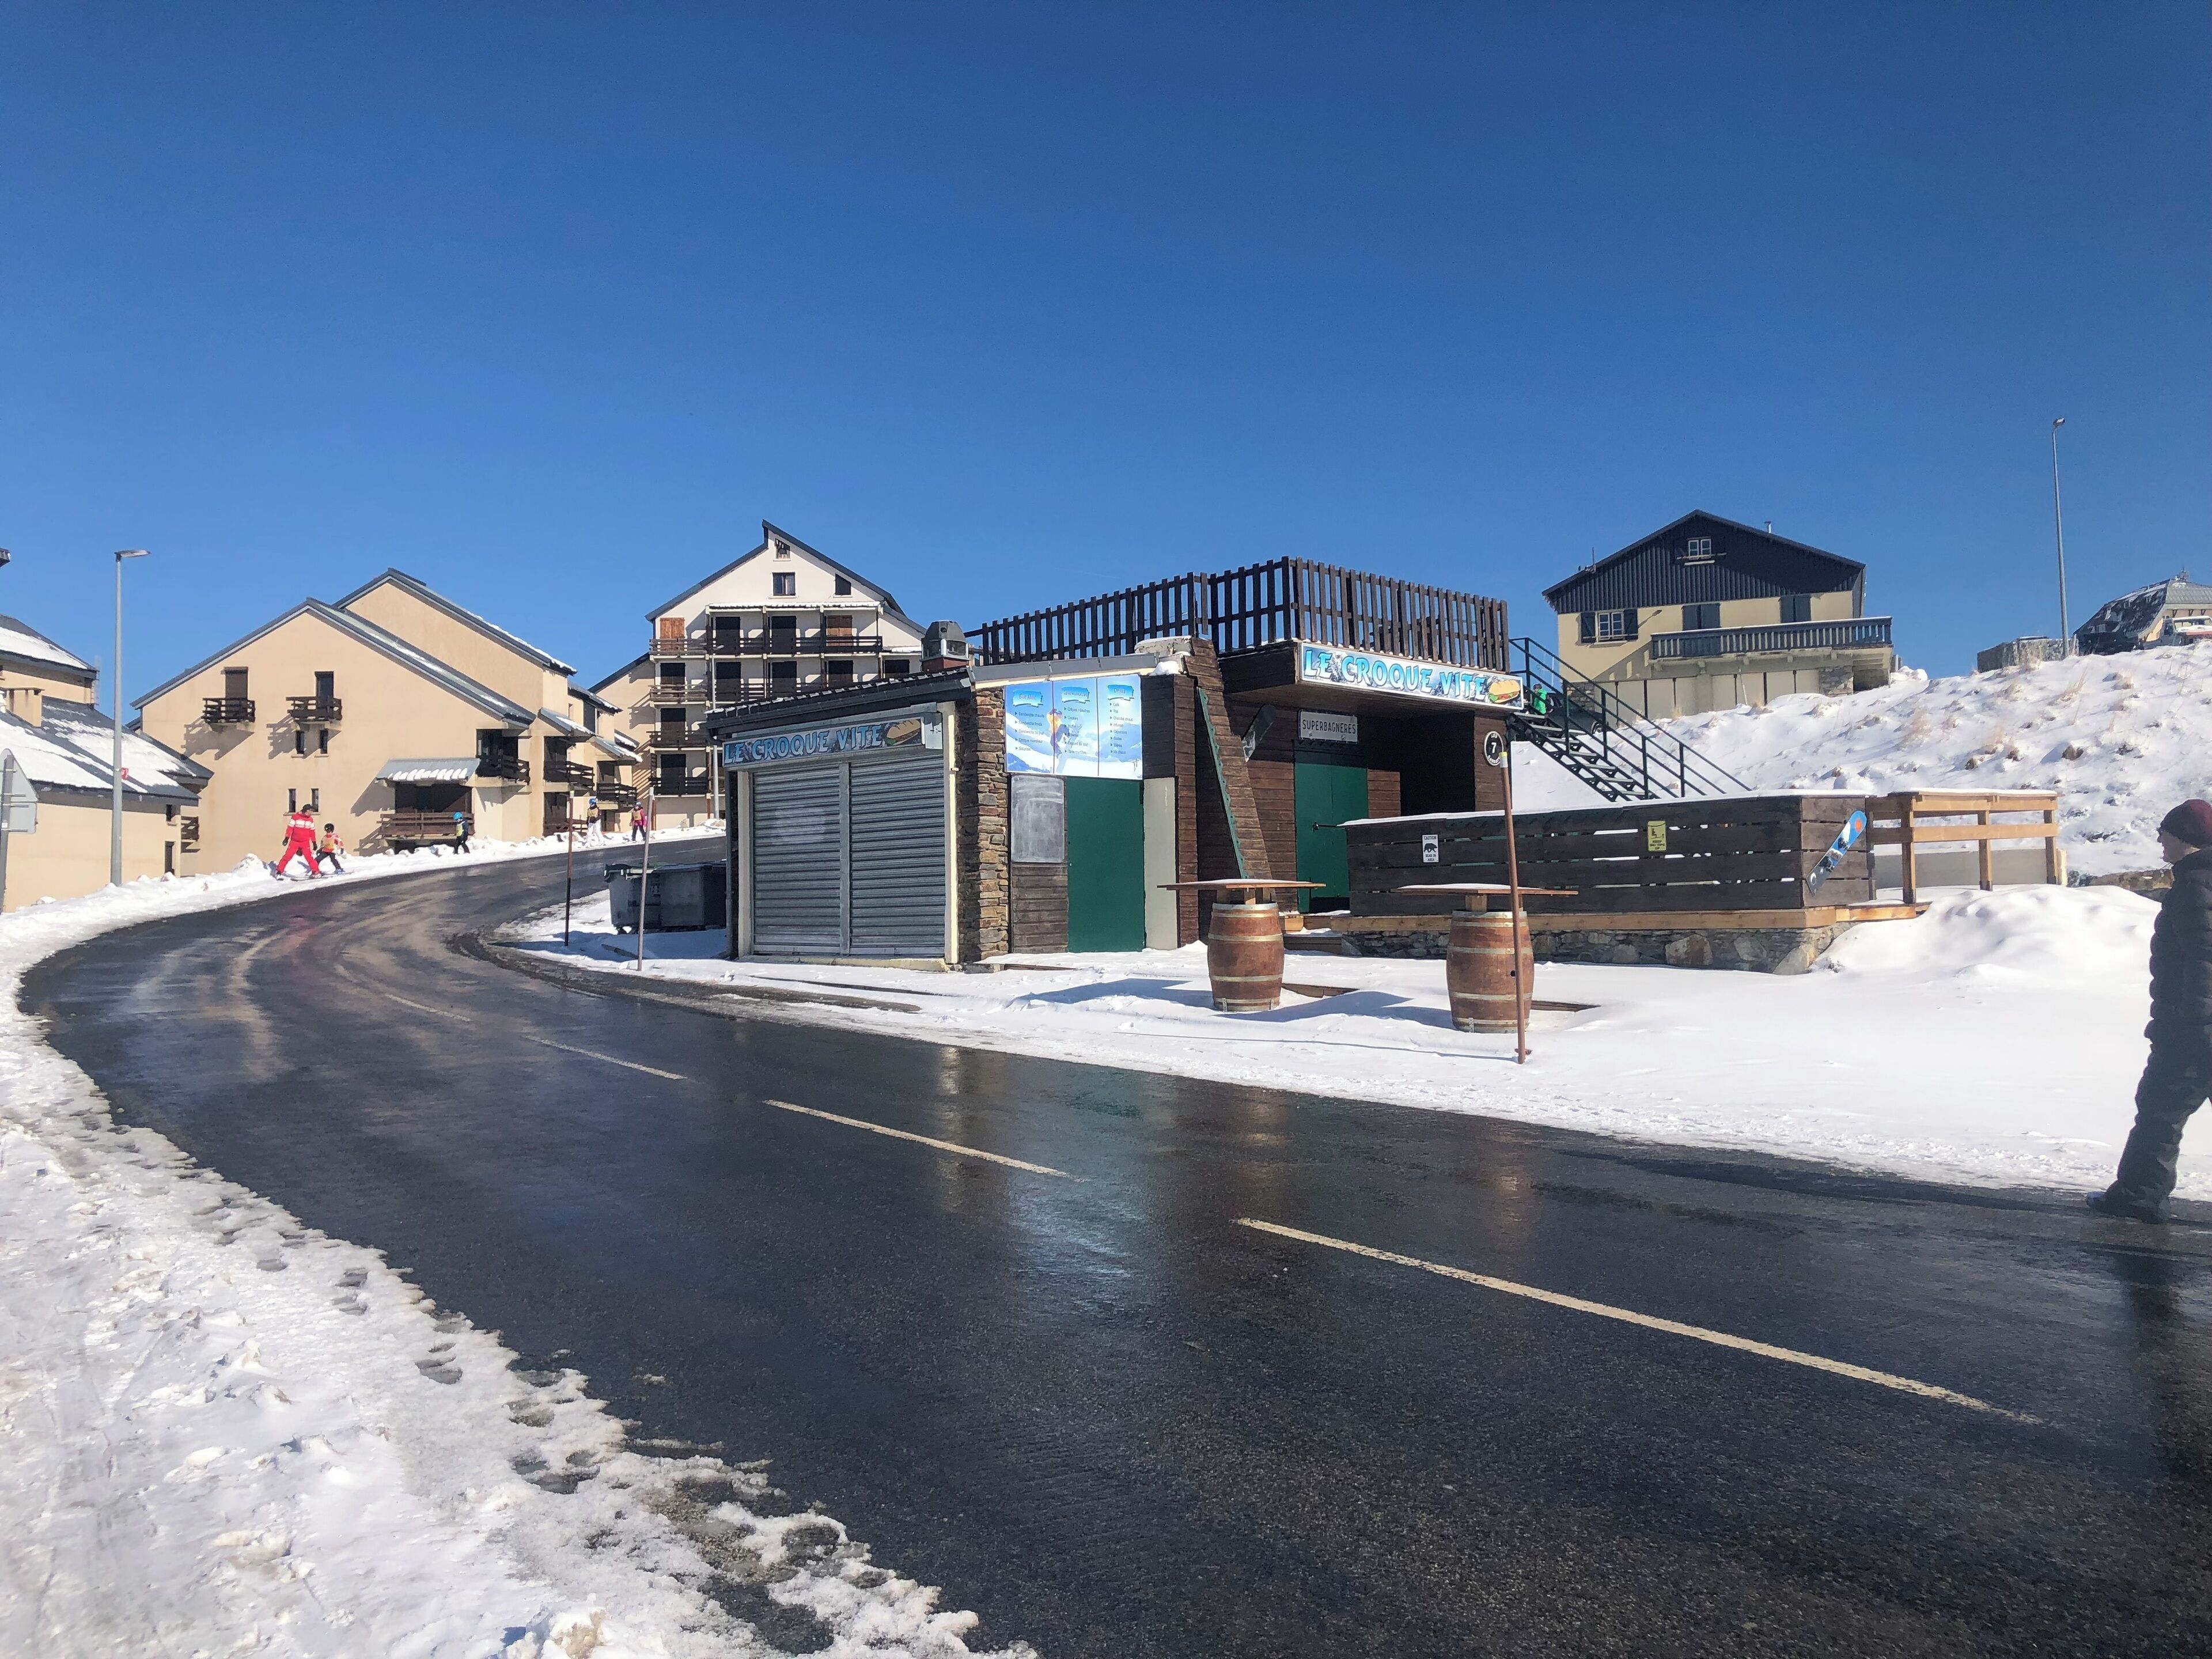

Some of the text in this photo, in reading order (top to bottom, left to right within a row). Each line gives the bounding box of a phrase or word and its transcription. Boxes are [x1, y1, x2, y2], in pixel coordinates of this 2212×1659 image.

[1304, 650, 1487, 700] LE CROQUE VITE
[1302, 719, 1356, 734] SUPERBAGNERES
[724, 724, 883, 764] LE CROQUE VITE
[1491, 742, 1497, 753] 7
